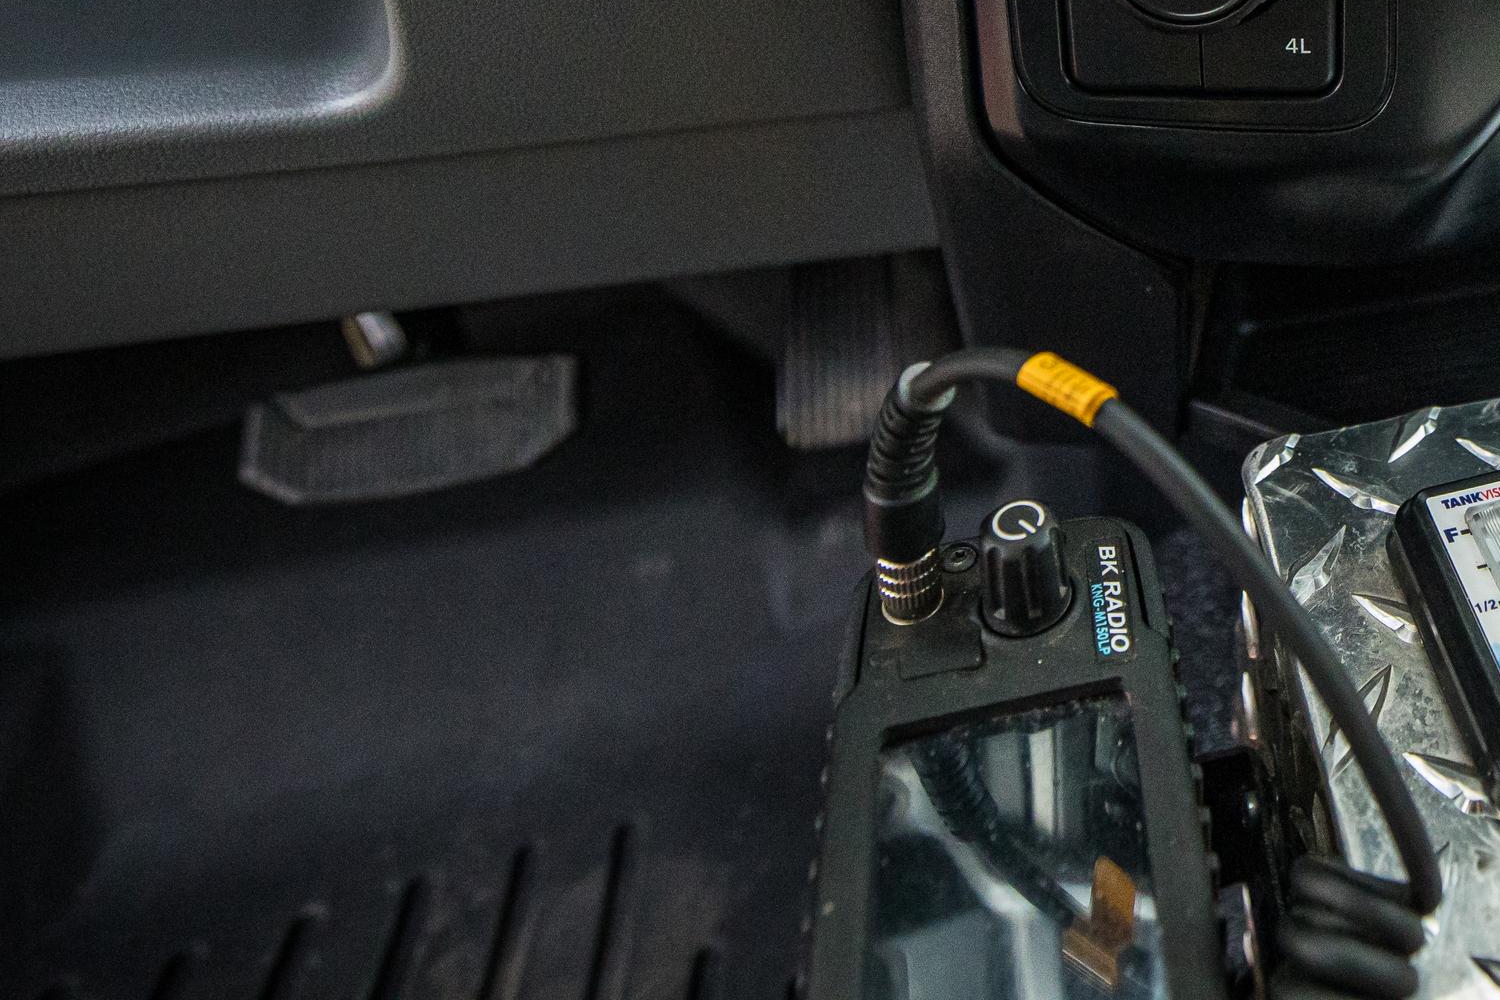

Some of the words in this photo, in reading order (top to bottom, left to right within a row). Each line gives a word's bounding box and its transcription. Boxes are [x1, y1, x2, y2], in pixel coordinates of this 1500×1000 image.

[1285, 37, 1312, 55] 4L
[1098, 546, 1119, 577] BK
[1091, 583, 1112, 656] KNG-M150LP
[1103, 581, 1130, 653] RADIO
[1474, 599, 1499, 614] 1/2
